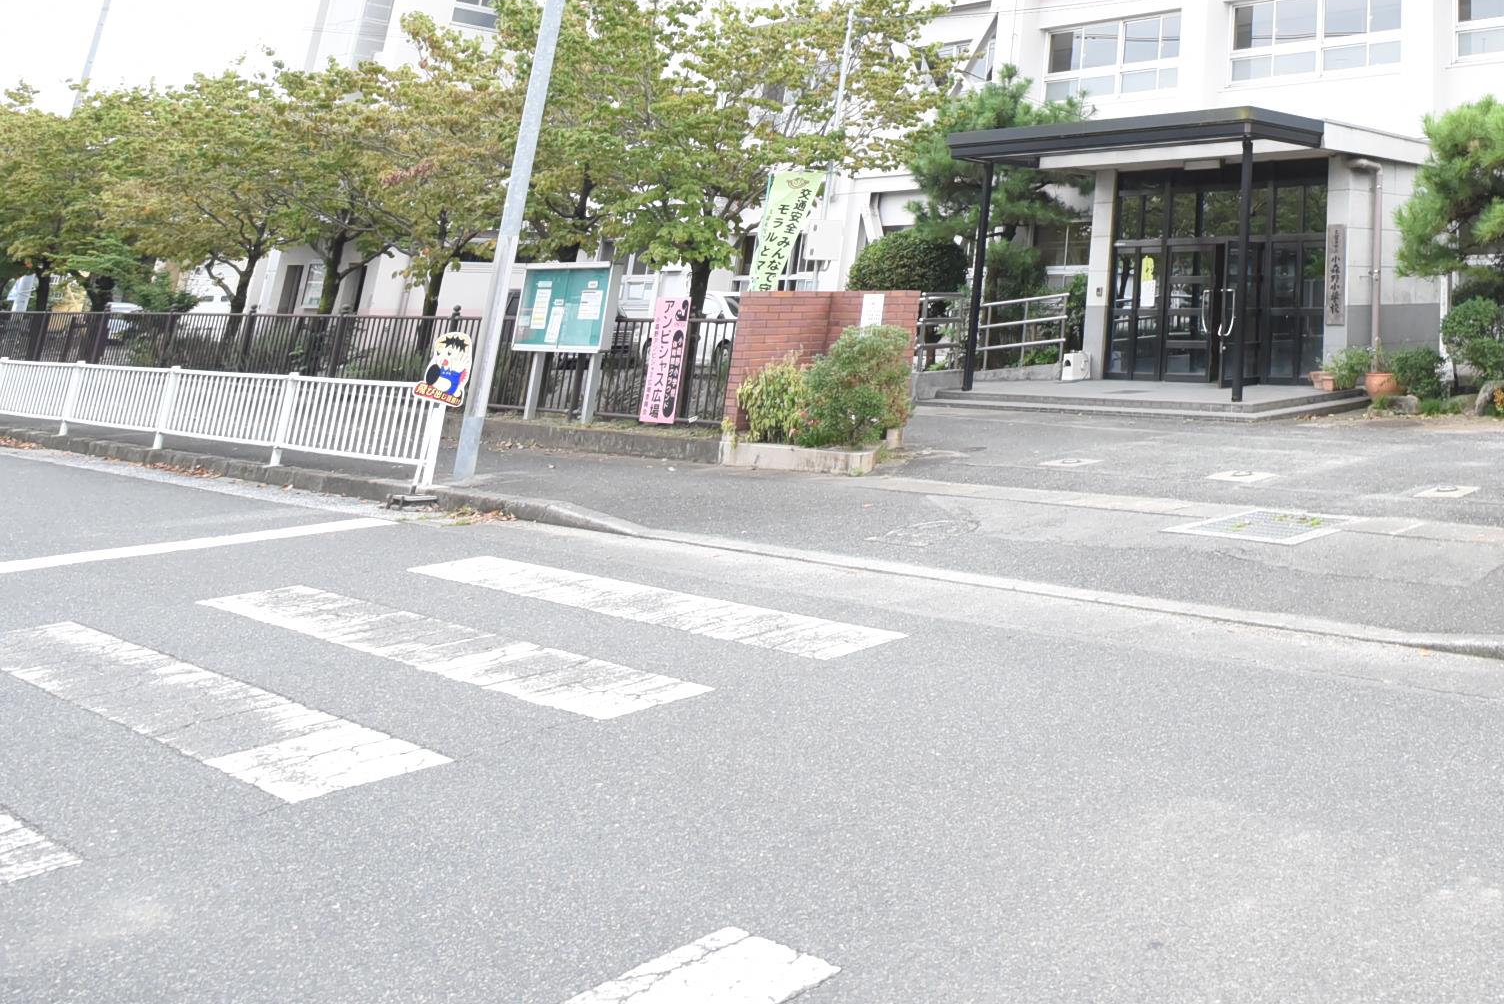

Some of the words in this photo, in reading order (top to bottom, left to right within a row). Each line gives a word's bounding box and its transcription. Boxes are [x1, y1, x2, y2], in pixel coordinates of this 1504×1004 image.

[649, 299, 676, 418] アンビシャス広場
